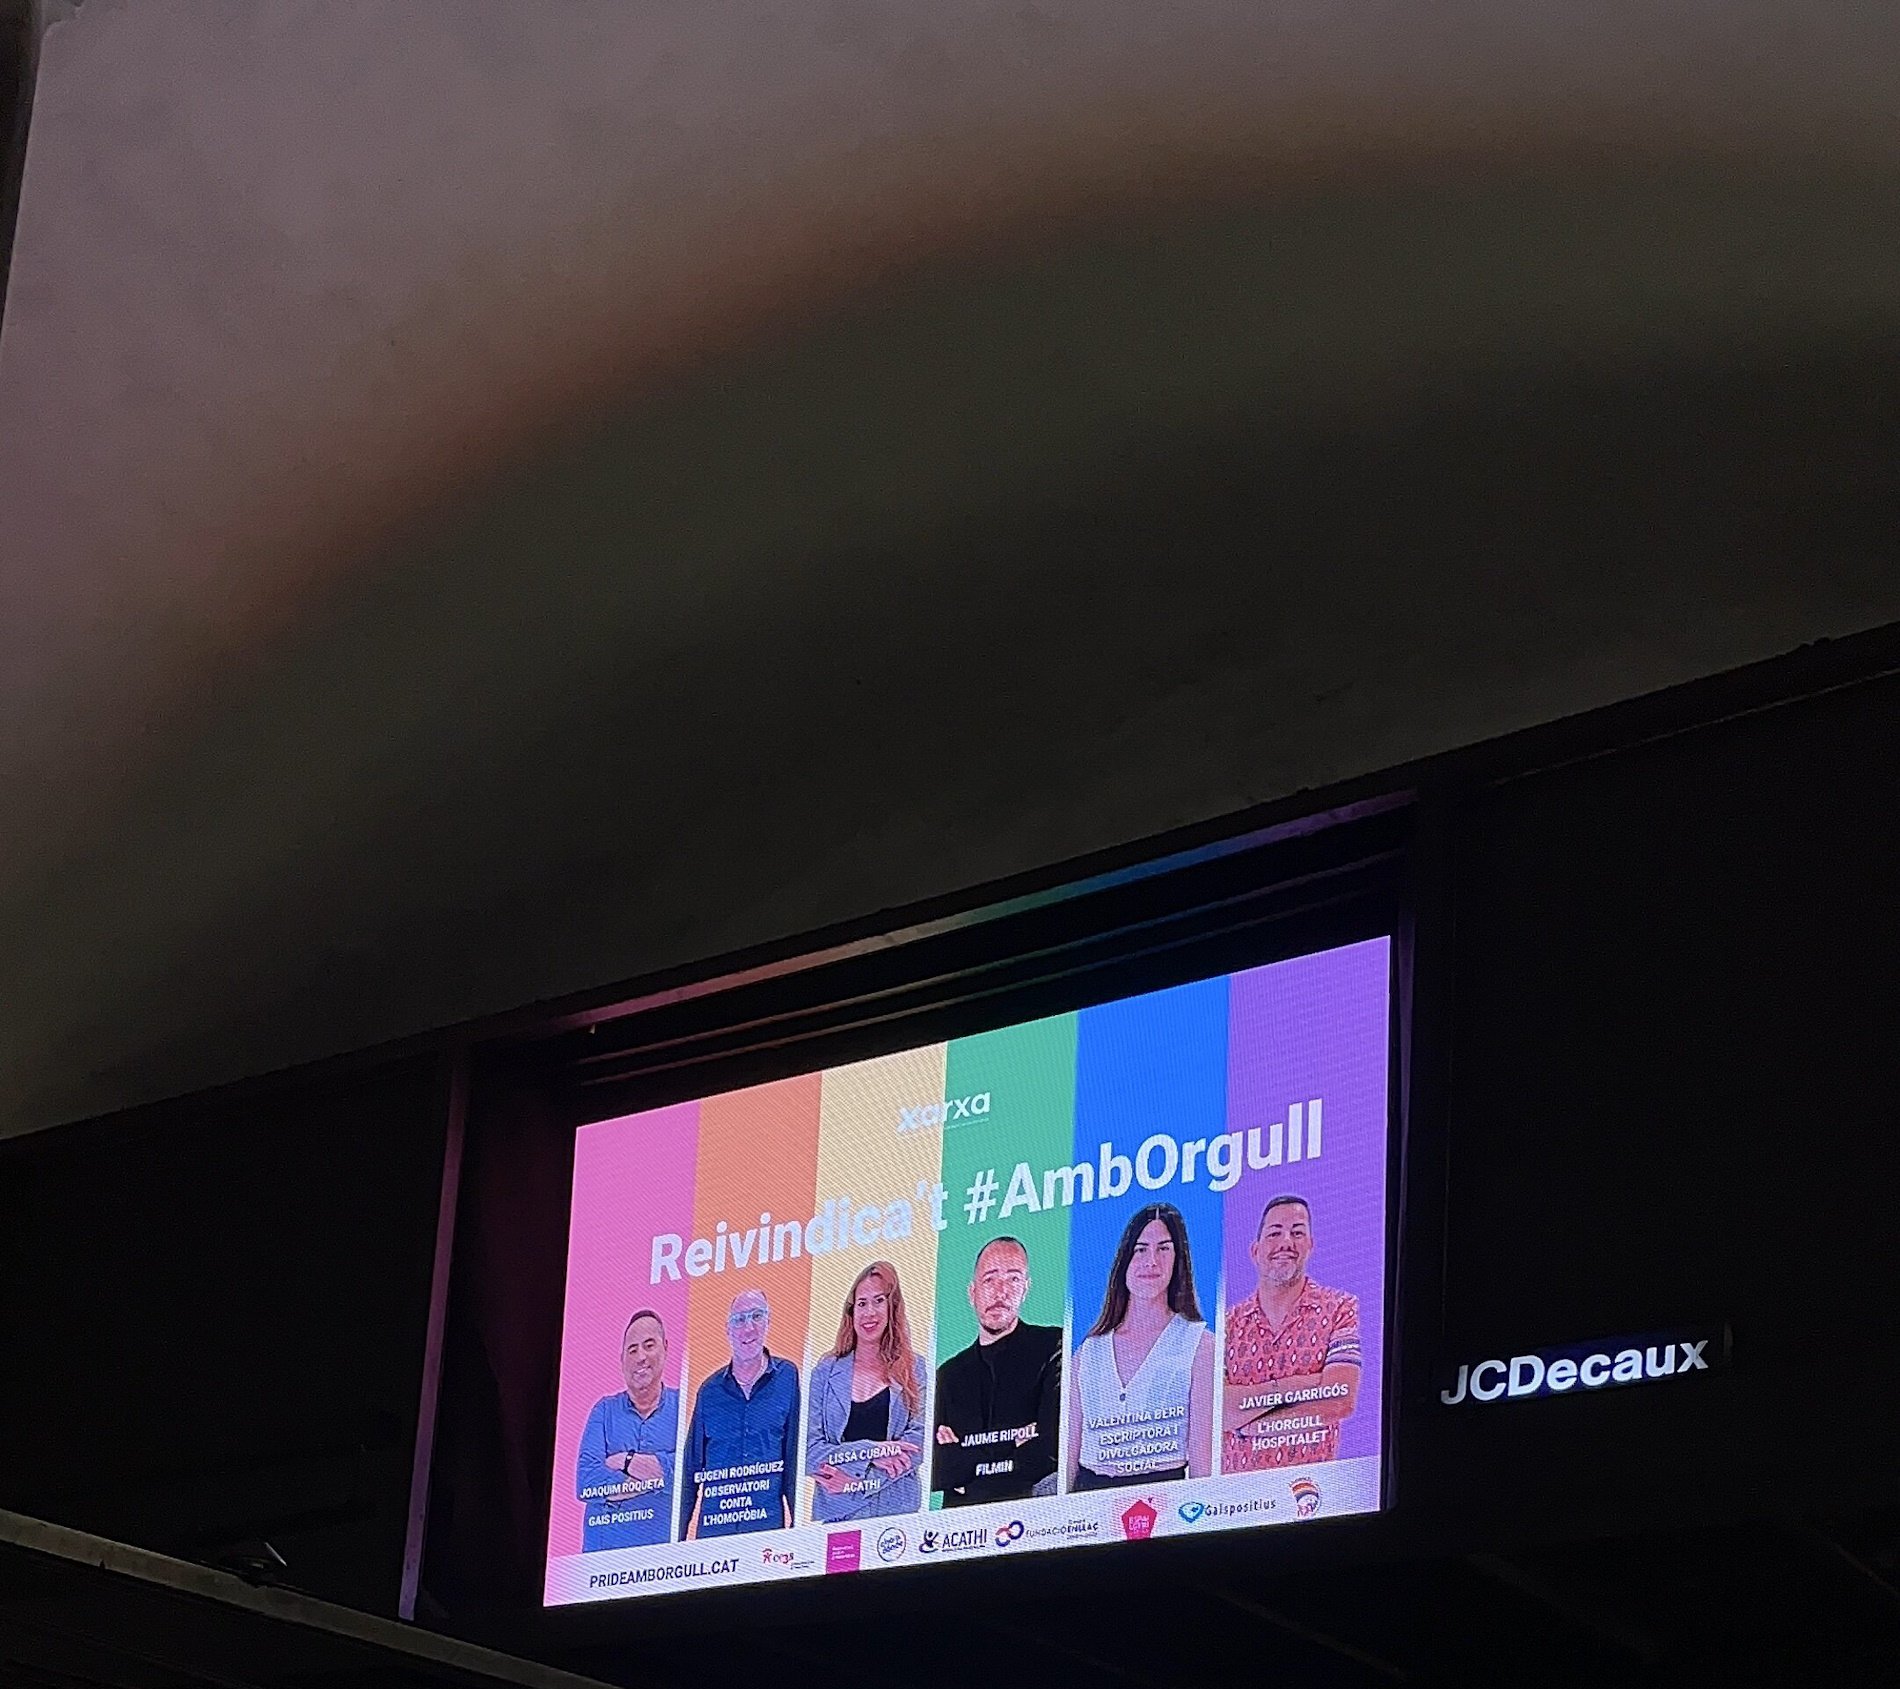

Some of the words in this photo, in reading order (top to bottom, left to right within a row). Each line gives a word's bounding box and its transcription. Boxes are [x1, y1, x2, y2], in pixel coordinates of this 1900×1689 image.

[896, 1092, 990, 1133] xarxa
[649, 1179, 949, 1285] Reivindica't
[963, 1098, 1323, 1225] #AmbOrgull
[1440, 1340, 1709, 1404] JCDecaux
[1239, 1393, 1282, 1410] JAVIER
[1285, 1383, 1349, 1404] GARRIGÓS
[1089, 1411, 1152, 1429] VALENTINA
[1257, 1415, 1323, 1434] L'HORGULL
[961, 1433, 999, 1447] JAUME
[1000, 1422, 1039, 1442] RIPOLL
[1100, 1425, 1171, 1446] ESCRIPTORA
[1253, 1429, 1329, 1451] HOSPITALET
[828, 1449, 858, 1465] LISSA
[859, 1445, 903, 1460] CUBANA
[1098, 1440, 1178, 1461] DIVULGADORA
[730, 1460, 785, 1479] RODRÍGUEZ
[975, 1460, 1014, 1476] FILMIN
[1117, 1460, 1158, 1473] SOCIAL
[580, 1482, 622, 1499] JOAQUIM
[622, 1477, 665, 1493] ROQUETA
[704, 1479, 770, 1499] OBSERVATORI
[842, 1480, 881, 1493] ACATHI
[720, 1496, 753, 1510] CONTA
[588, 1511, 611, 1527] GAIS
[611, 1508, 655, 1523] POSITIUS
[941, 1528, 988, 1549] ACATHI
[589, 1557, 740, 1589] PRIDEAMBORGULL.CAT
